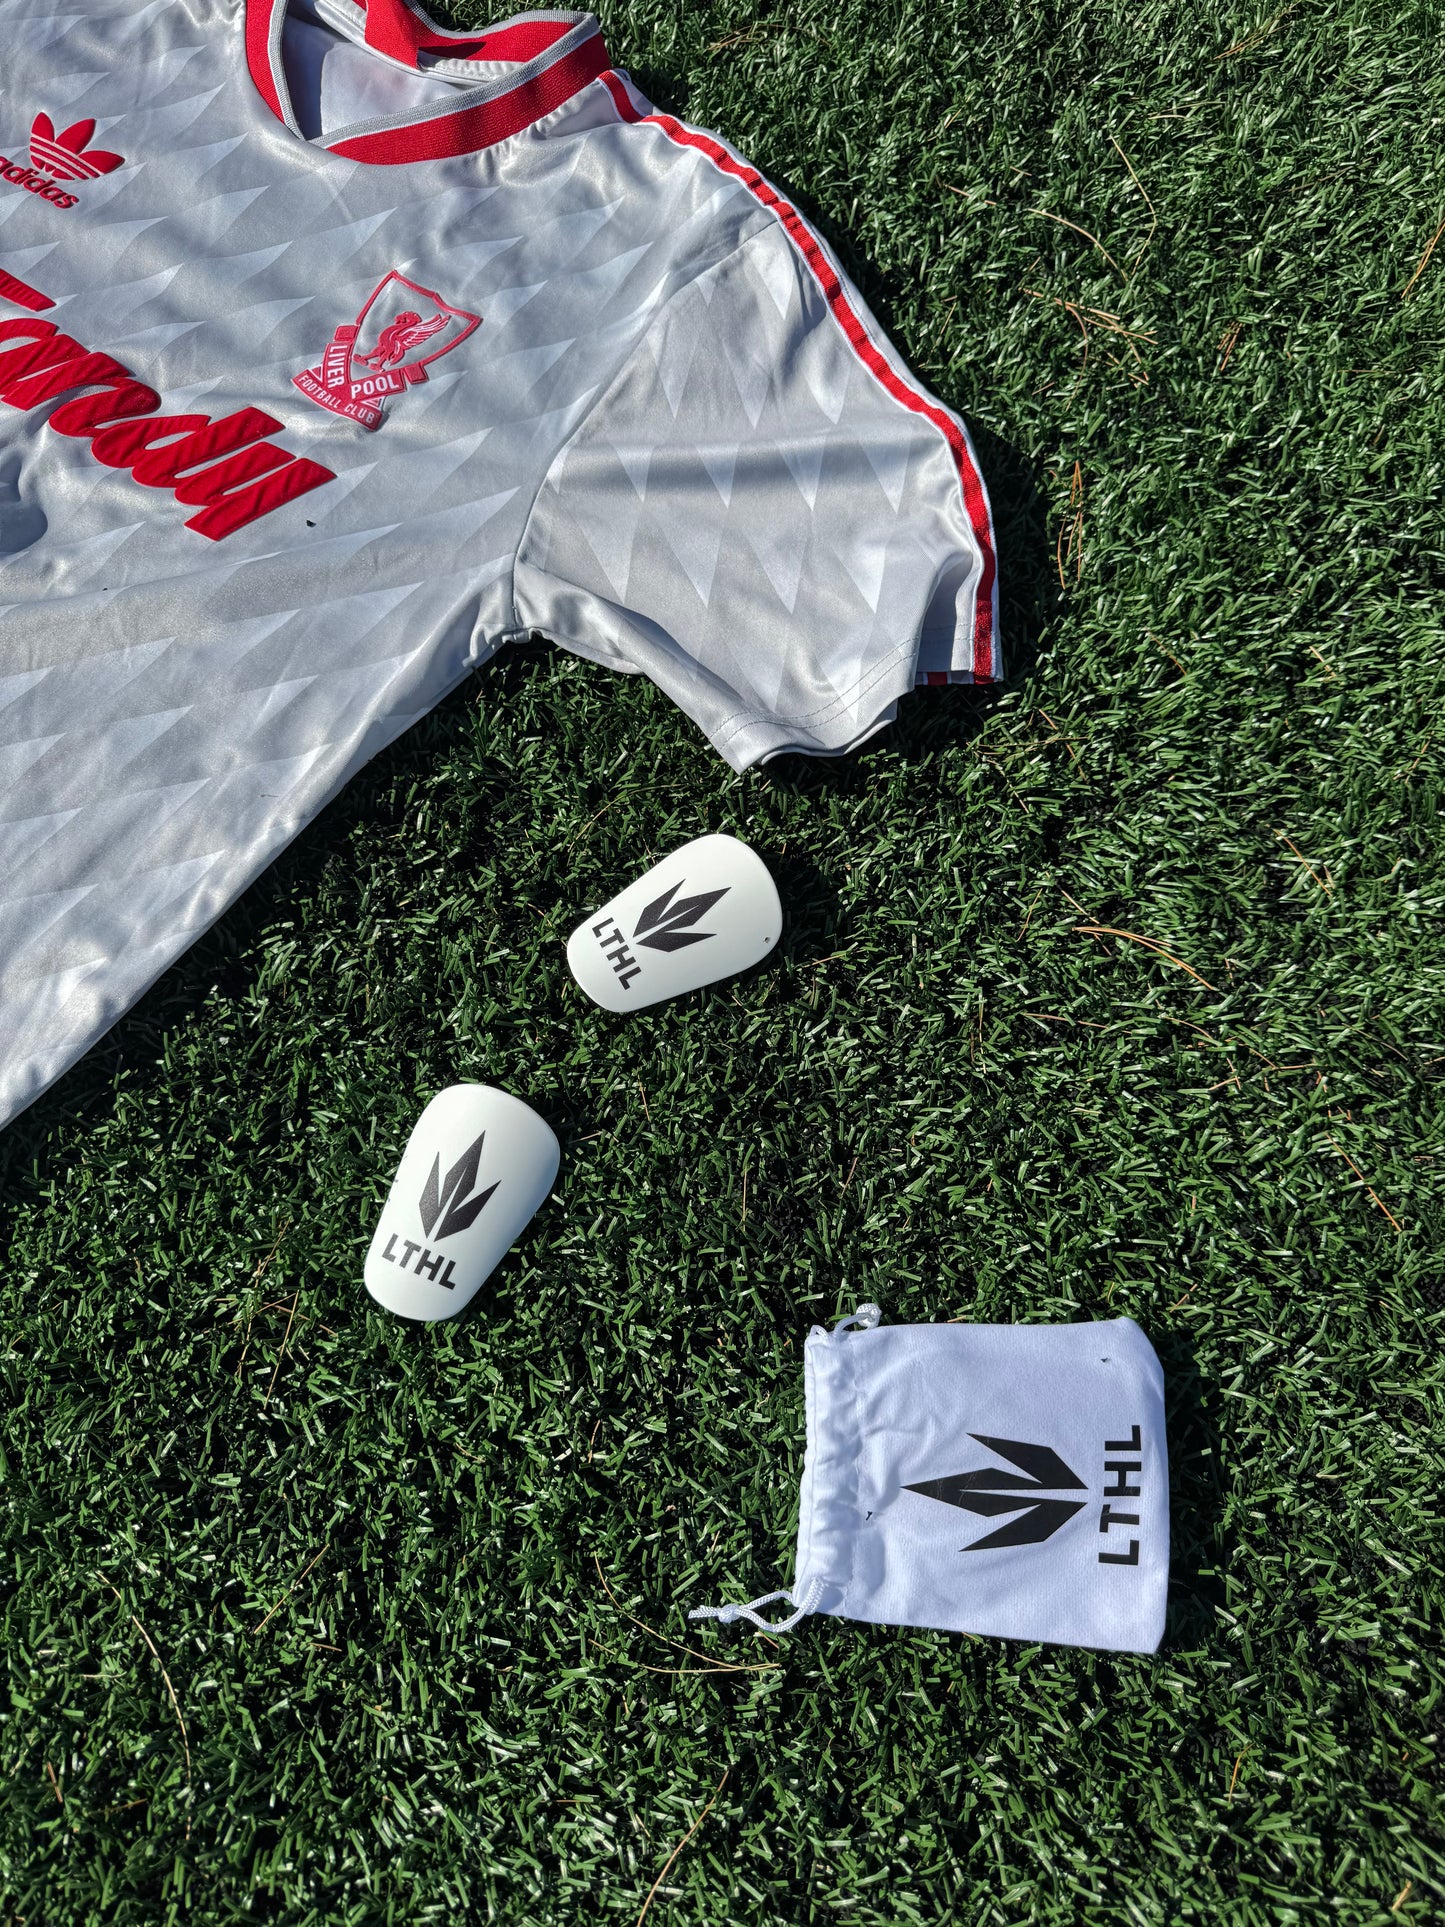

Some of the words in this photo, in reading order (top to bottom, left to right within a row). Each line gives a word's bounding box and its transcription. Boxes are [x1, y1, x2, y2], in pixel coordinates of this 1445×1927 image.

[327, 344, 347, 388] LIVER
[351, 375, 399, 399] POOL
[0, 269, 336, 542] andy
[299, 374, 340, 409] FOOTBALL
[344, 403, 374, 424] CLUB
[592, 917, 642, 991] LTHL
[382, 1233, 457, 1290] LTHL
[1098, 1424, 1142, 1566] LTHL
